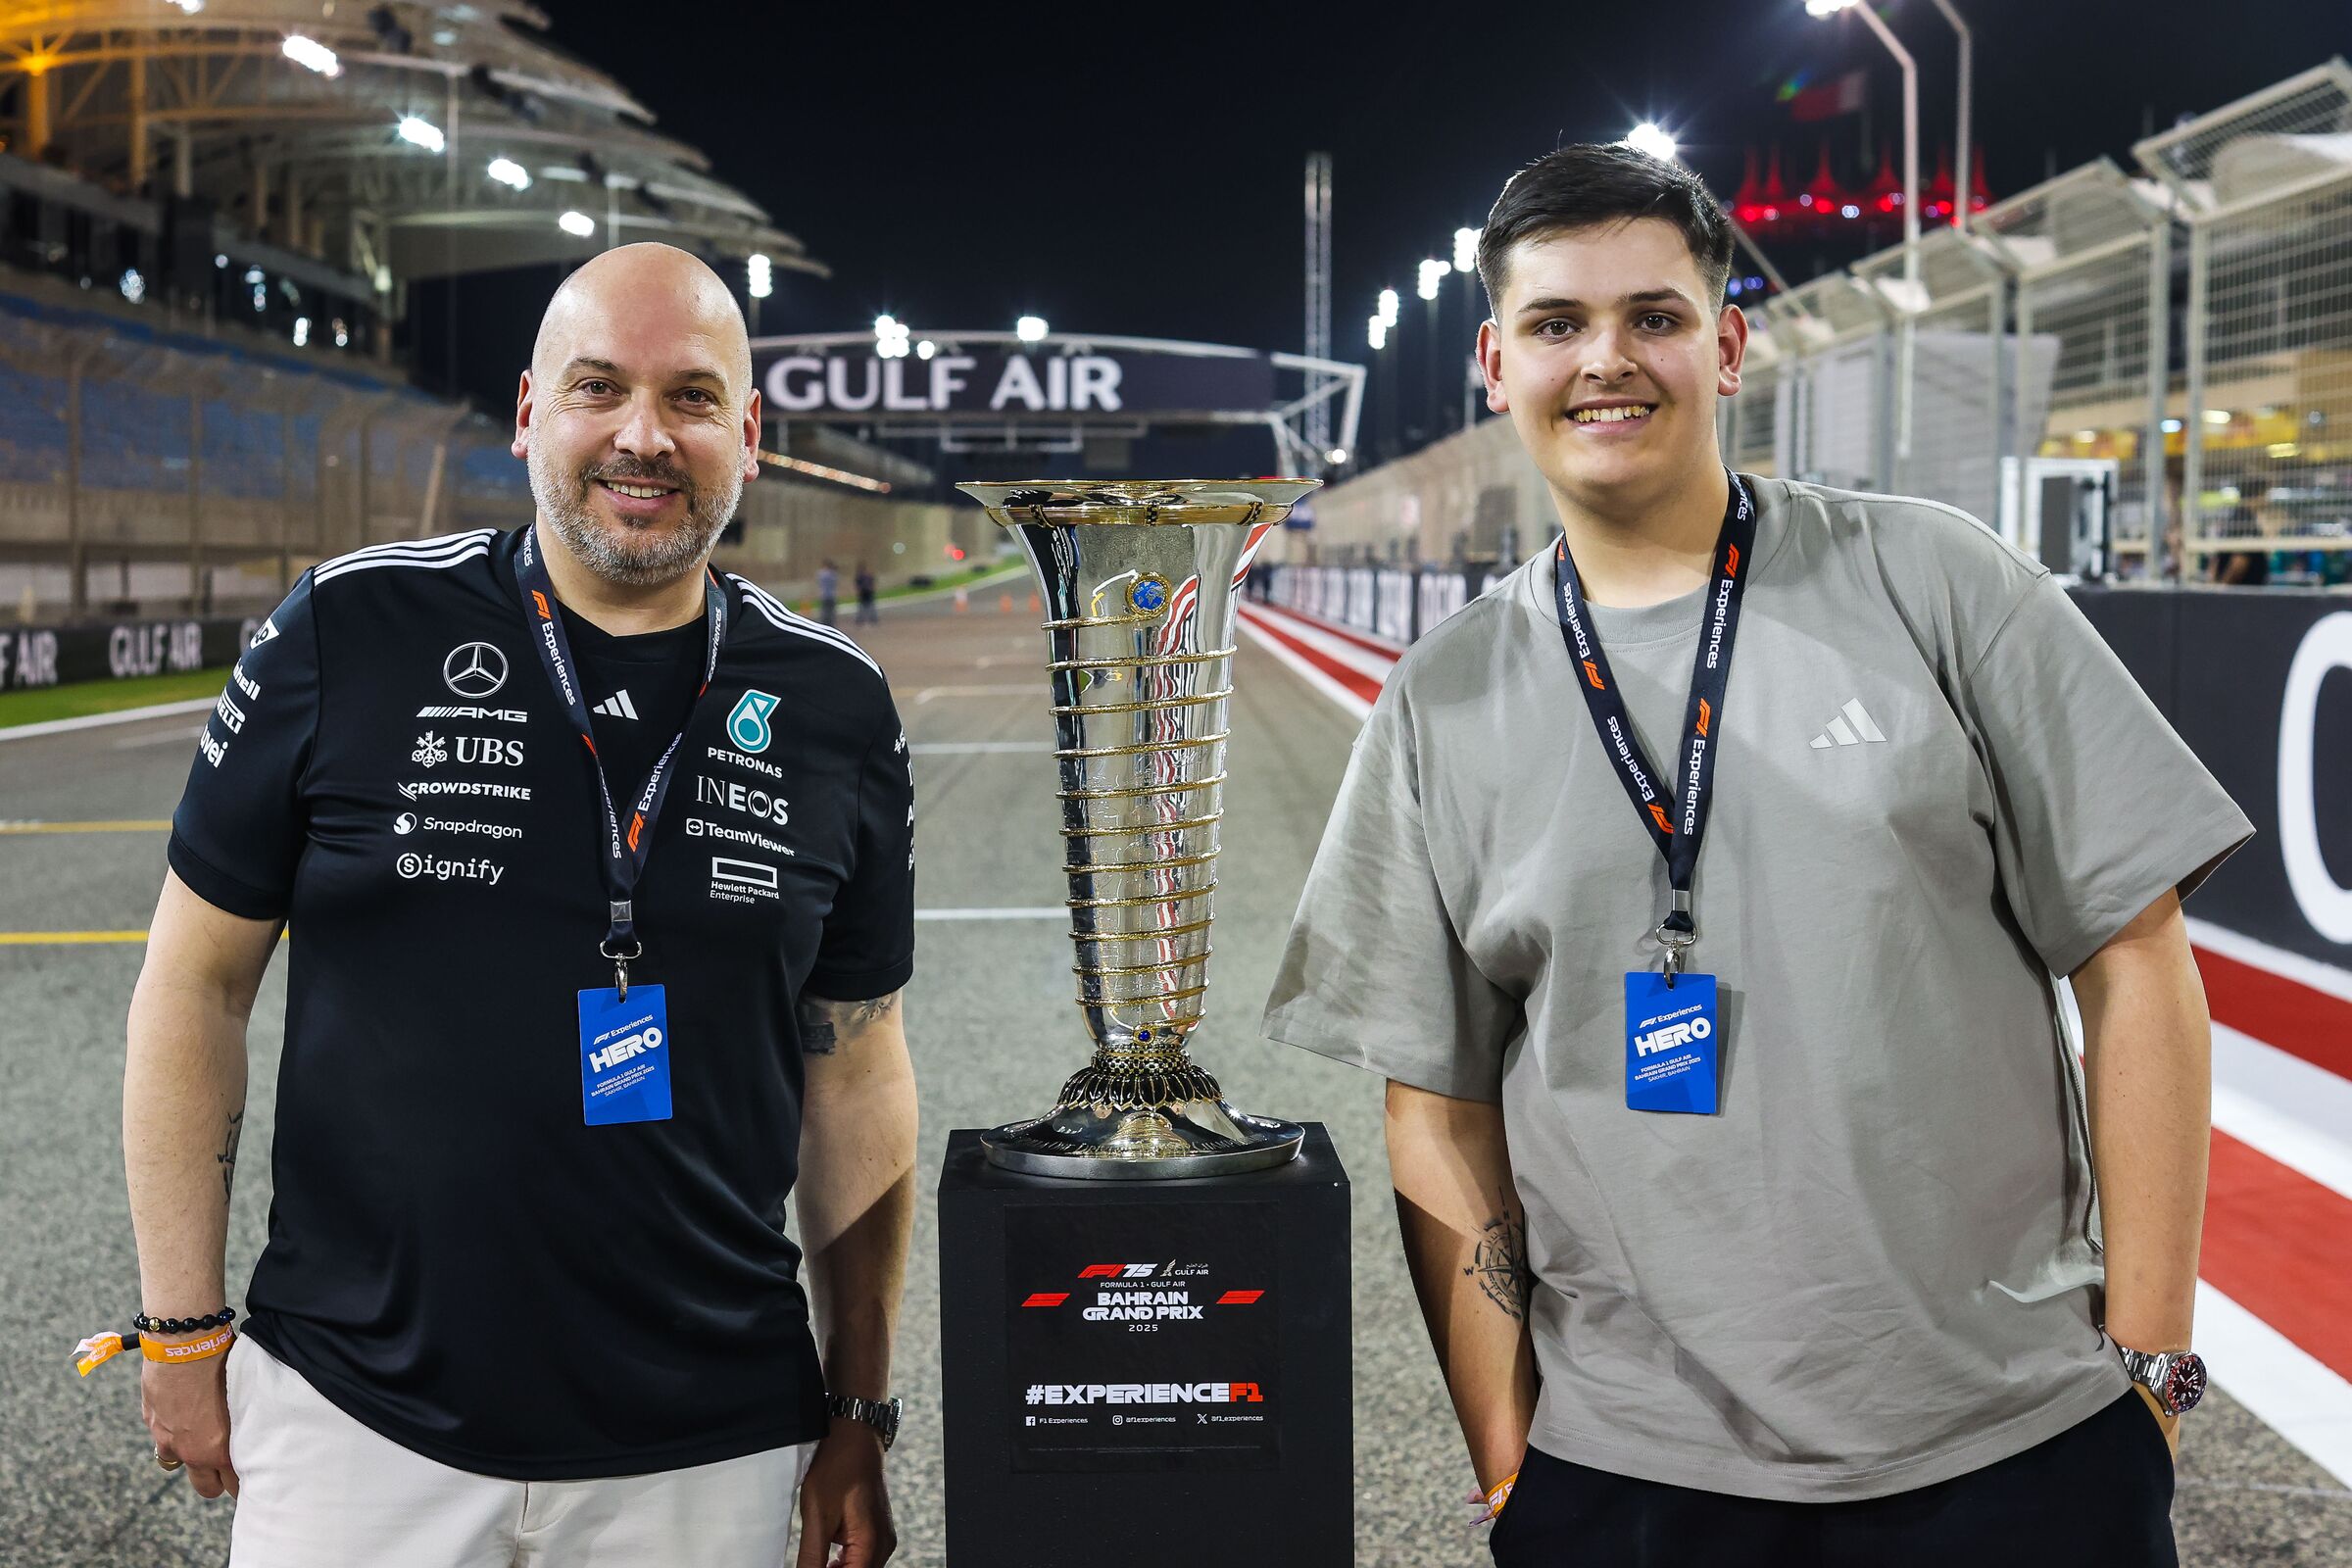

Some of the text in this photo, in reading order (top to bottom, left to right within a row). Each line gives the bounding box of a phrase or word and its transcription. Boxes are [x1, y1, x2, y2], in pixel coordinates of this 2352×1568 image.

[765, 355, 1123, 412] GULF AIR
[1563, 581, 1591, 659] Experiences
[1707, 579, 1734, 669] Experiences
[541, 621, 576, 706] Experiences
[454, 707, 528, 723] AMG
[455, 736, 524, 766] UBS
[708, 746, 783, 779] PETRONAS
[1607, 715, 1655, 802] Experiences
[637, 732, 683, 811] Experiences
[1684, 739, 1706, 836] Experiences
[406, 781, 531, 801] CROWDSTRIKE
[696, 775, 789, 826] INEOS
[422, 816, 522, 840] Snapdragon
[705, 821, 796, 858] TeamViewer
[710, 880, 780, 901] Hewlett Packard
[710, 890, 756, 905] Enterprise
[611, 1014, 654, 1037] Experiences
[1657, 1004, 1703, 1023] Experiences
[588, 1027, 663, 1073] HERO
[1634, 1017, 1711, 1057] HERO
[1082, 1305, 1204, 1321] GRAND PRIX
[1097, 1291, 1189, 1306] BAHRAIN
[1025, 1383, 1263, 1405] #EXPERIENCEF1
